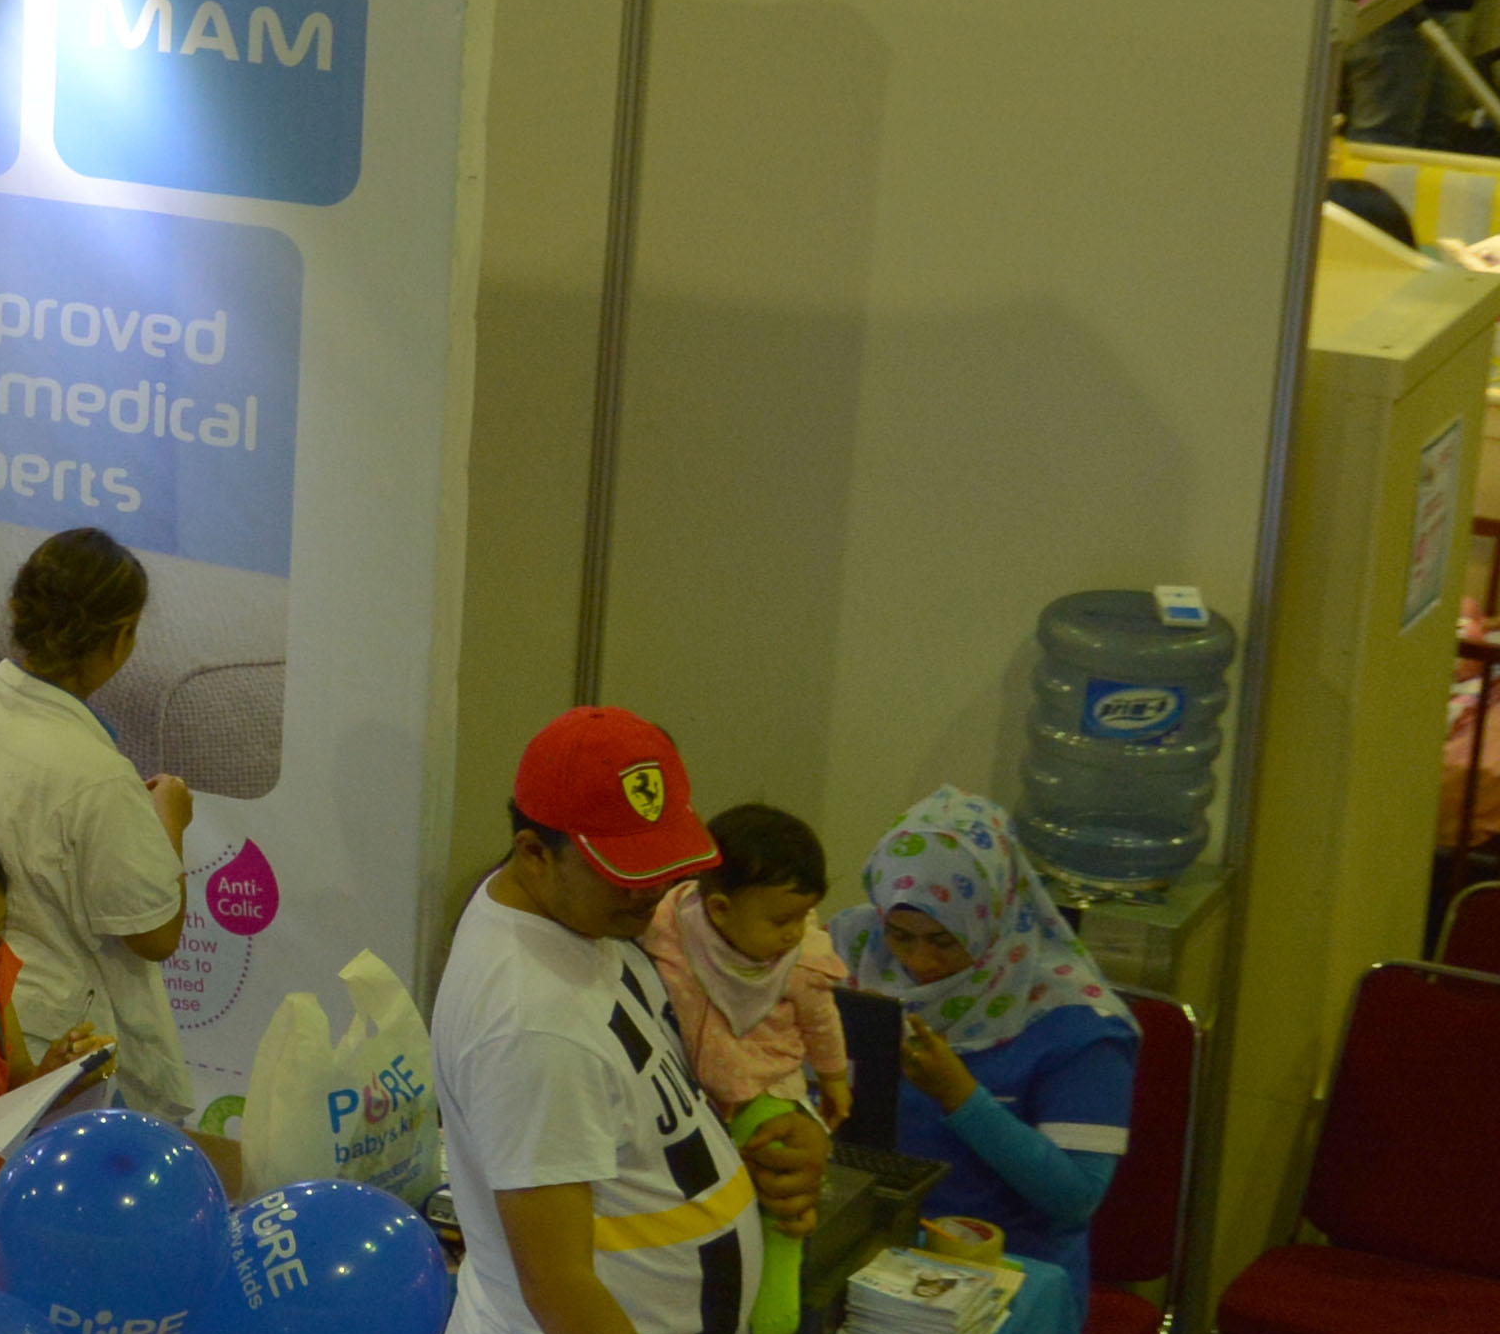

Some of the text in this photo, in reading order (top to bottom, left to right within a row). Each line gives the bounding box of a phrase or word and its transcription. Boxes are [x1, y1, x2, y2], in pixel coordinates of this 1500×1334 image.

[0, 371, 258, 452] medical
[217, 875, 263, 897] Anti-
[217, 897, 264, 920] Colic
[327, 1054, 426, 1135] PURE
[251, 1190, 309, 1299] PURE
